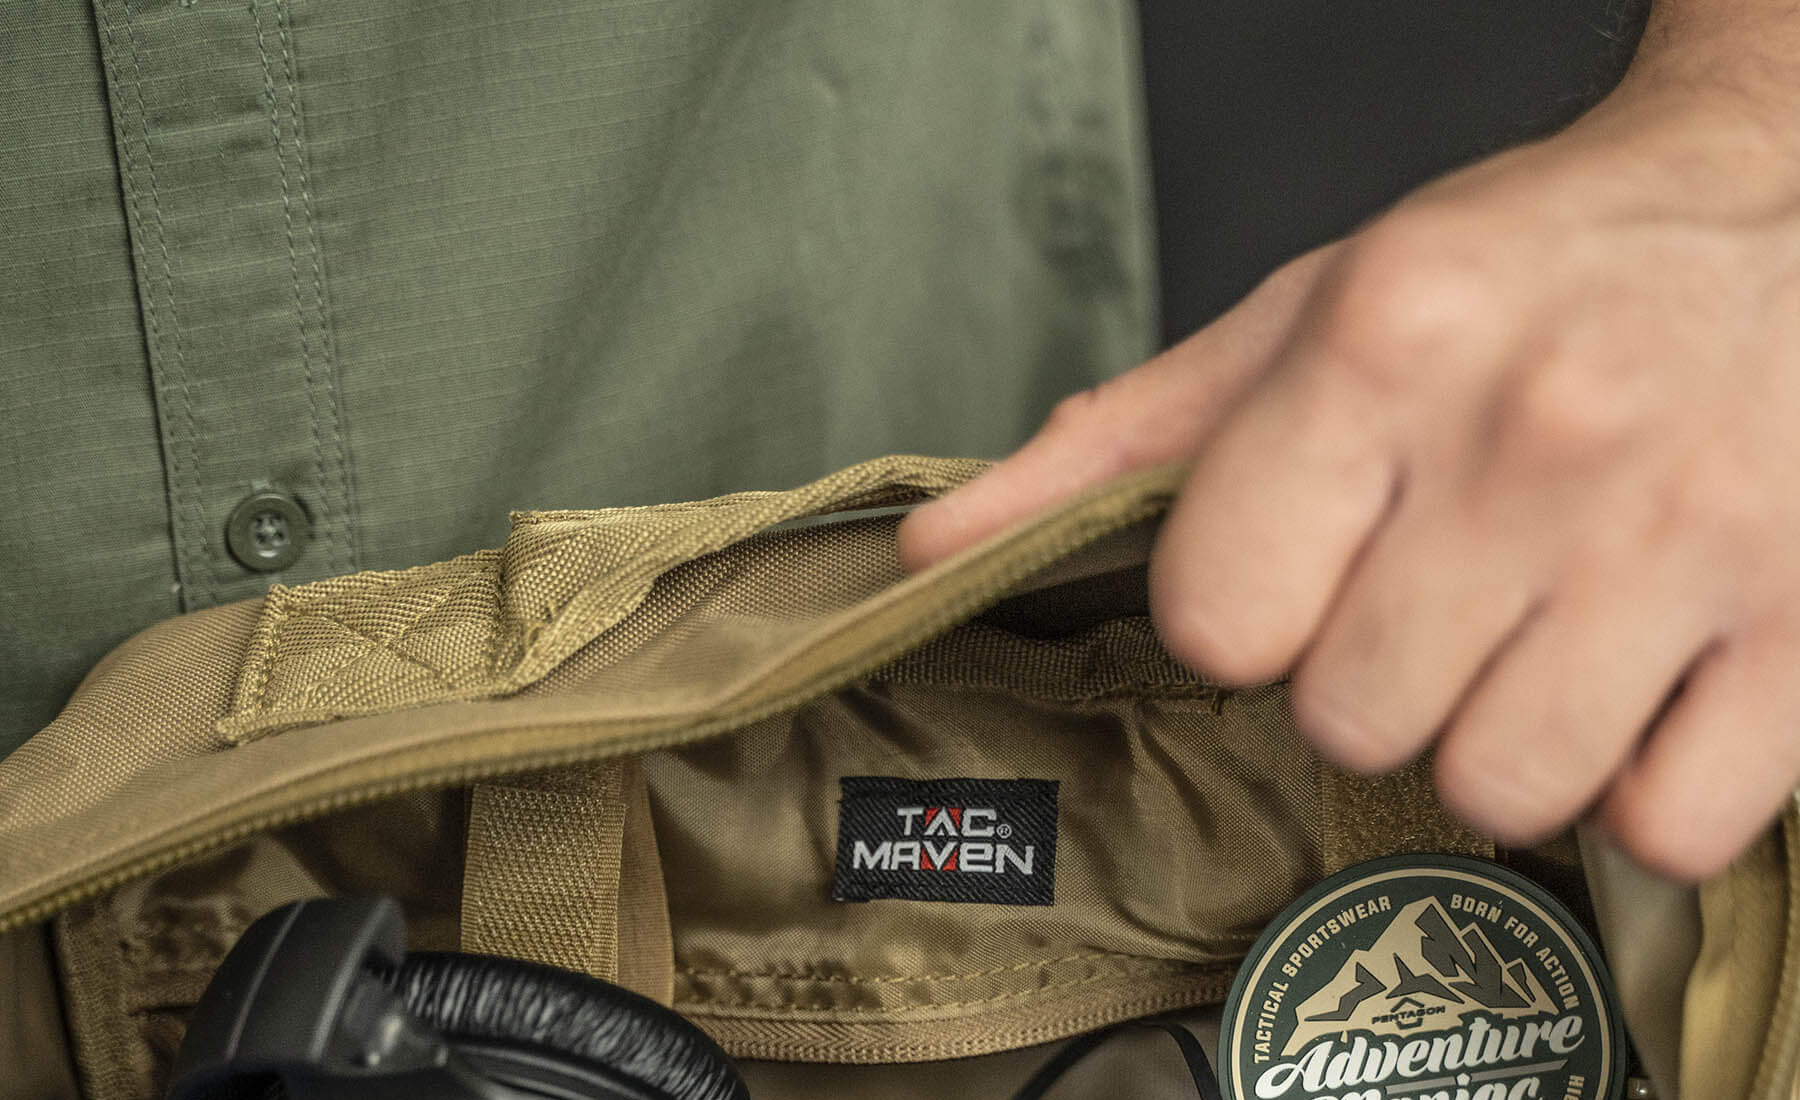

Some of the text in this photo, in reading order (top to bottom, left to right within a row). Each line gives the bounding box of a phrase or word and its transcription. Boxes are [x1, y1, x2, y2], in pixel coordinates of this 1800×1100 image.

[852, 840, 1035, 875] MAVEN
[1254, 895, 1393, 1065] TACTICAL SPORTSWEAR
[1450, 893, 1581, 1011] BORN FOR ACTION
[1254, 1014, 1586, 1100] Adventure
[1371, 1005, 1446, 1025] PENTAGON
